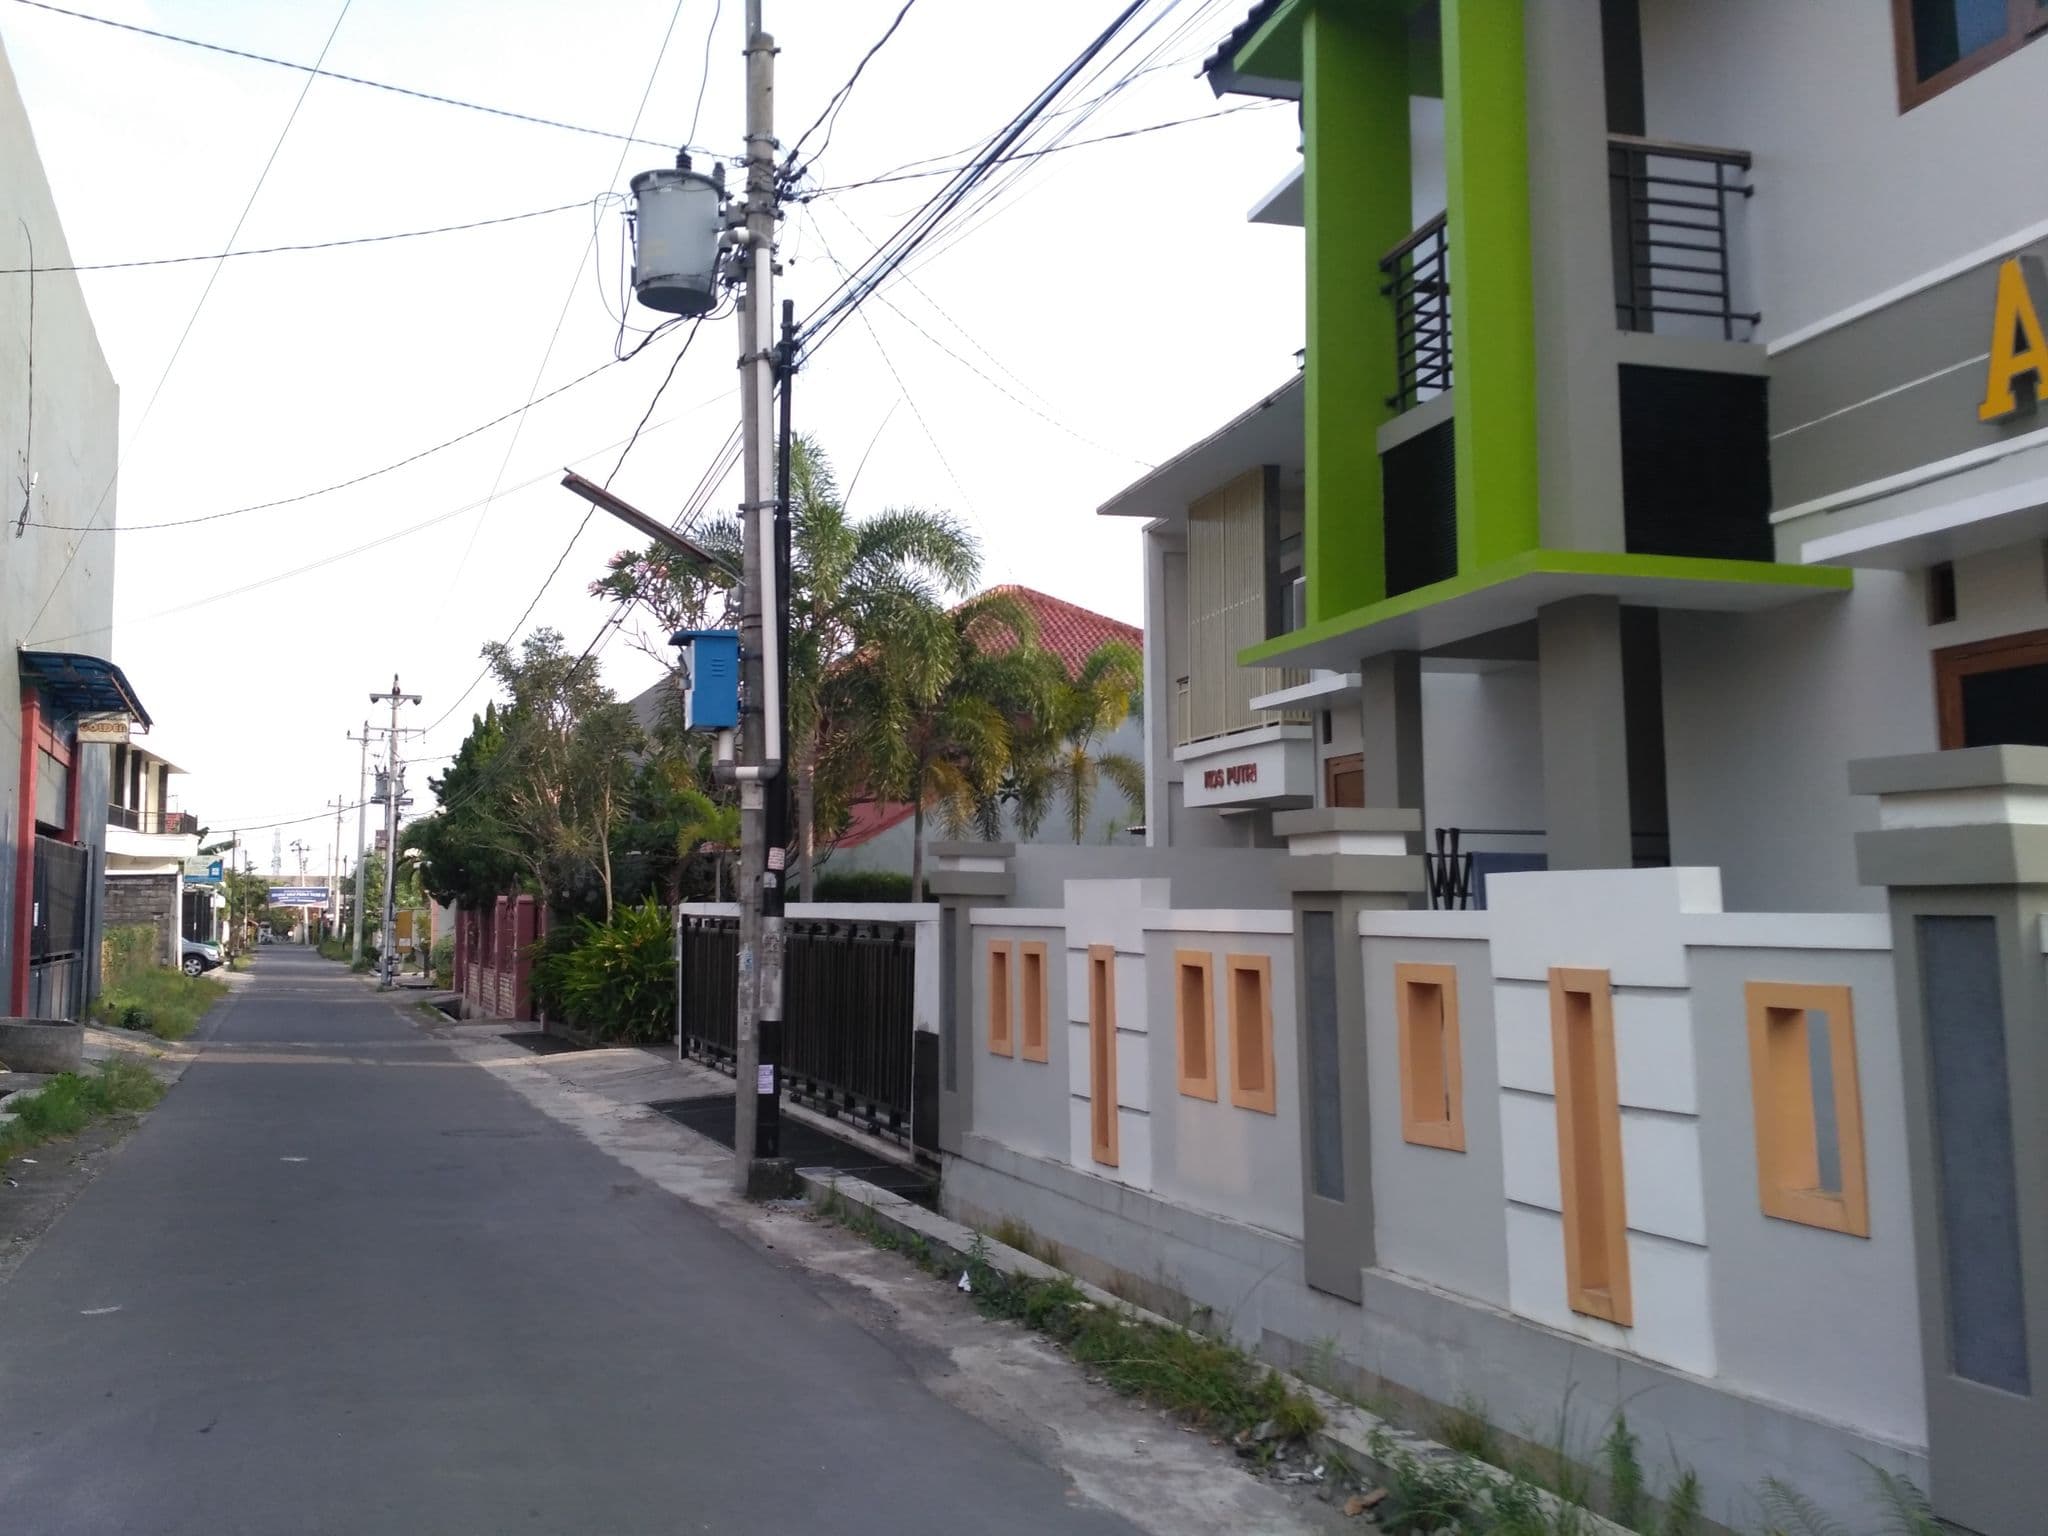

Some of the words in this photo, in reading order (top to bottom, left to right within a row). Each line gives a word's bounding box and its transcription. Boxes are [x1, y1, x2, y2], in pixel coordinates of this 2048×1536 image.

[1977, 257, 2048, 422] A
[1204, 768, 1225, 789] KOS
[1226, 763, 1257, 786] PUTRI
